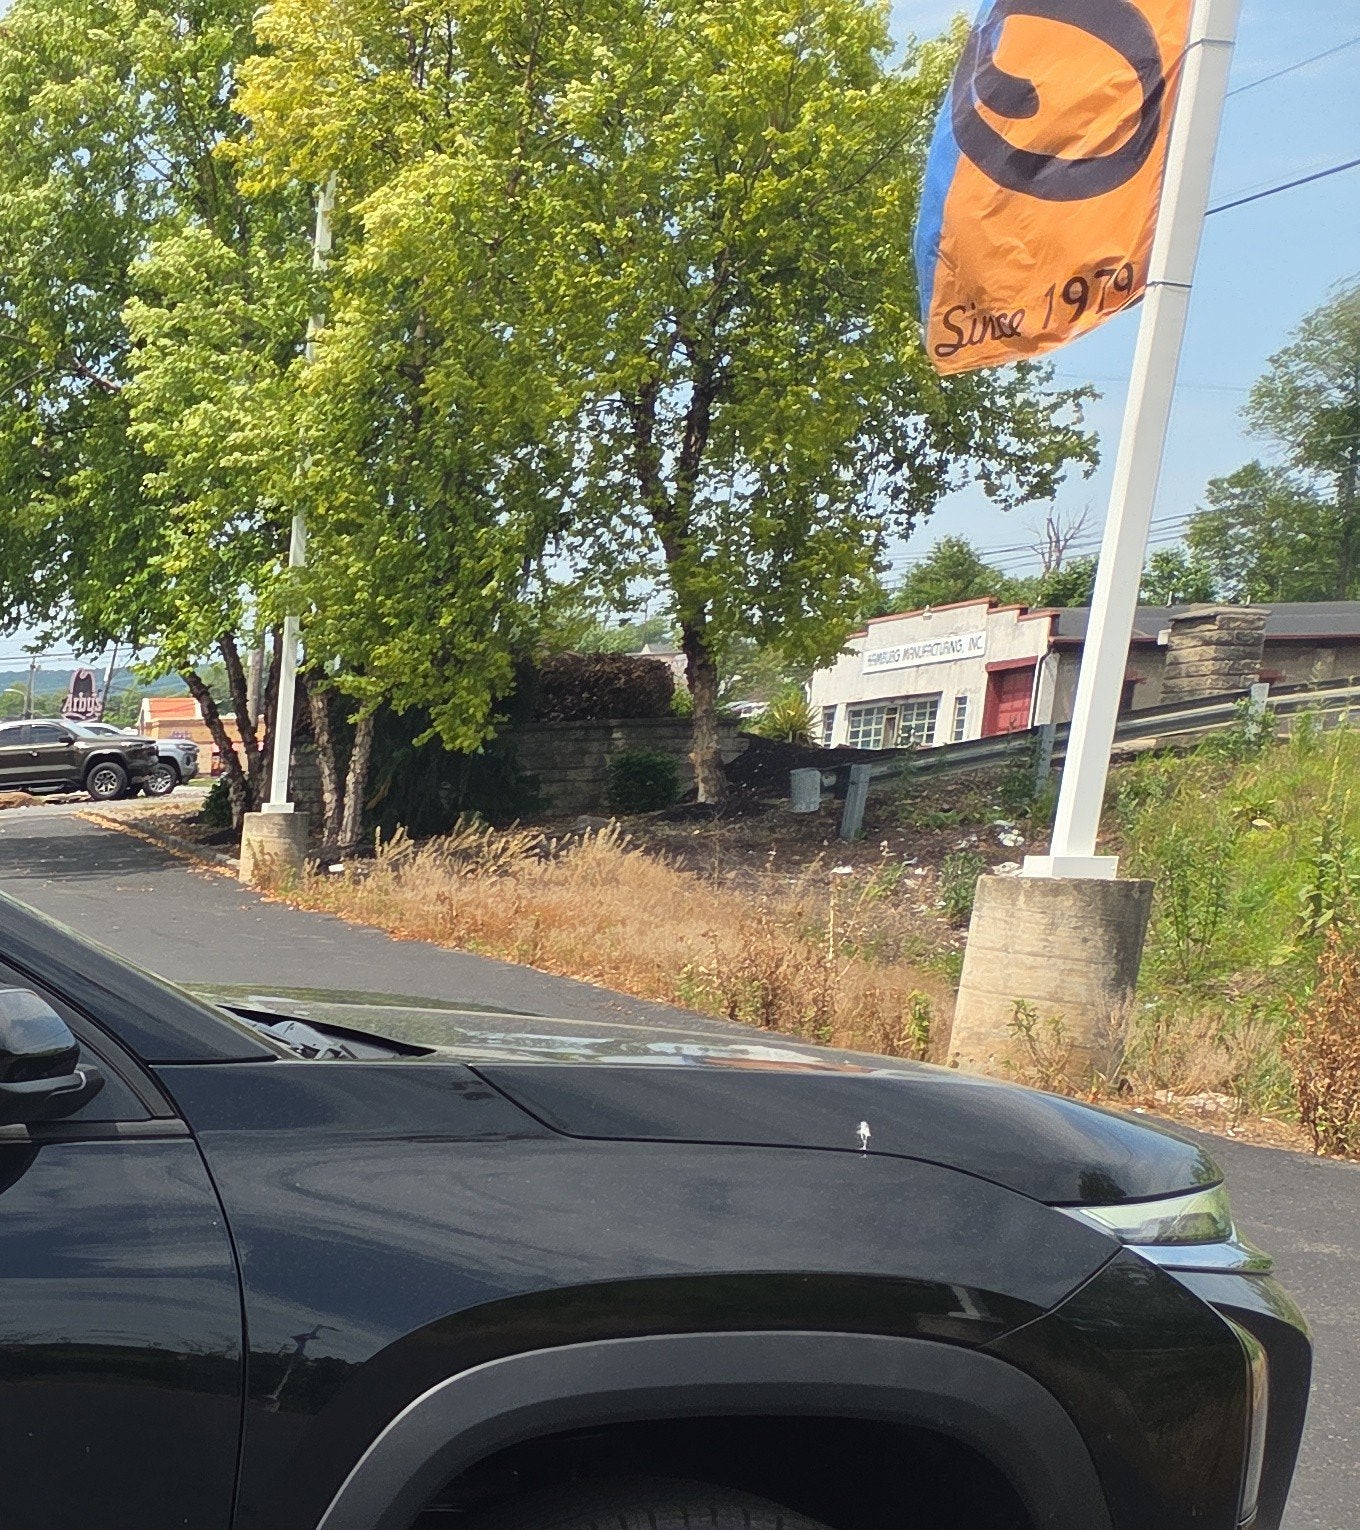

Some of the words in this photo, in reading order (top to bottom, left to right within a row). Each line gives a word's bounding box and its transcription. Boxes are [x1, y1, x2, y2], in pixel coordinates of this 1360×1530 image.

[935, 302, 1025, 357] Since
[1042, 262, 1134, 330] 1979
[62, 692, 103, 716] Arby's
